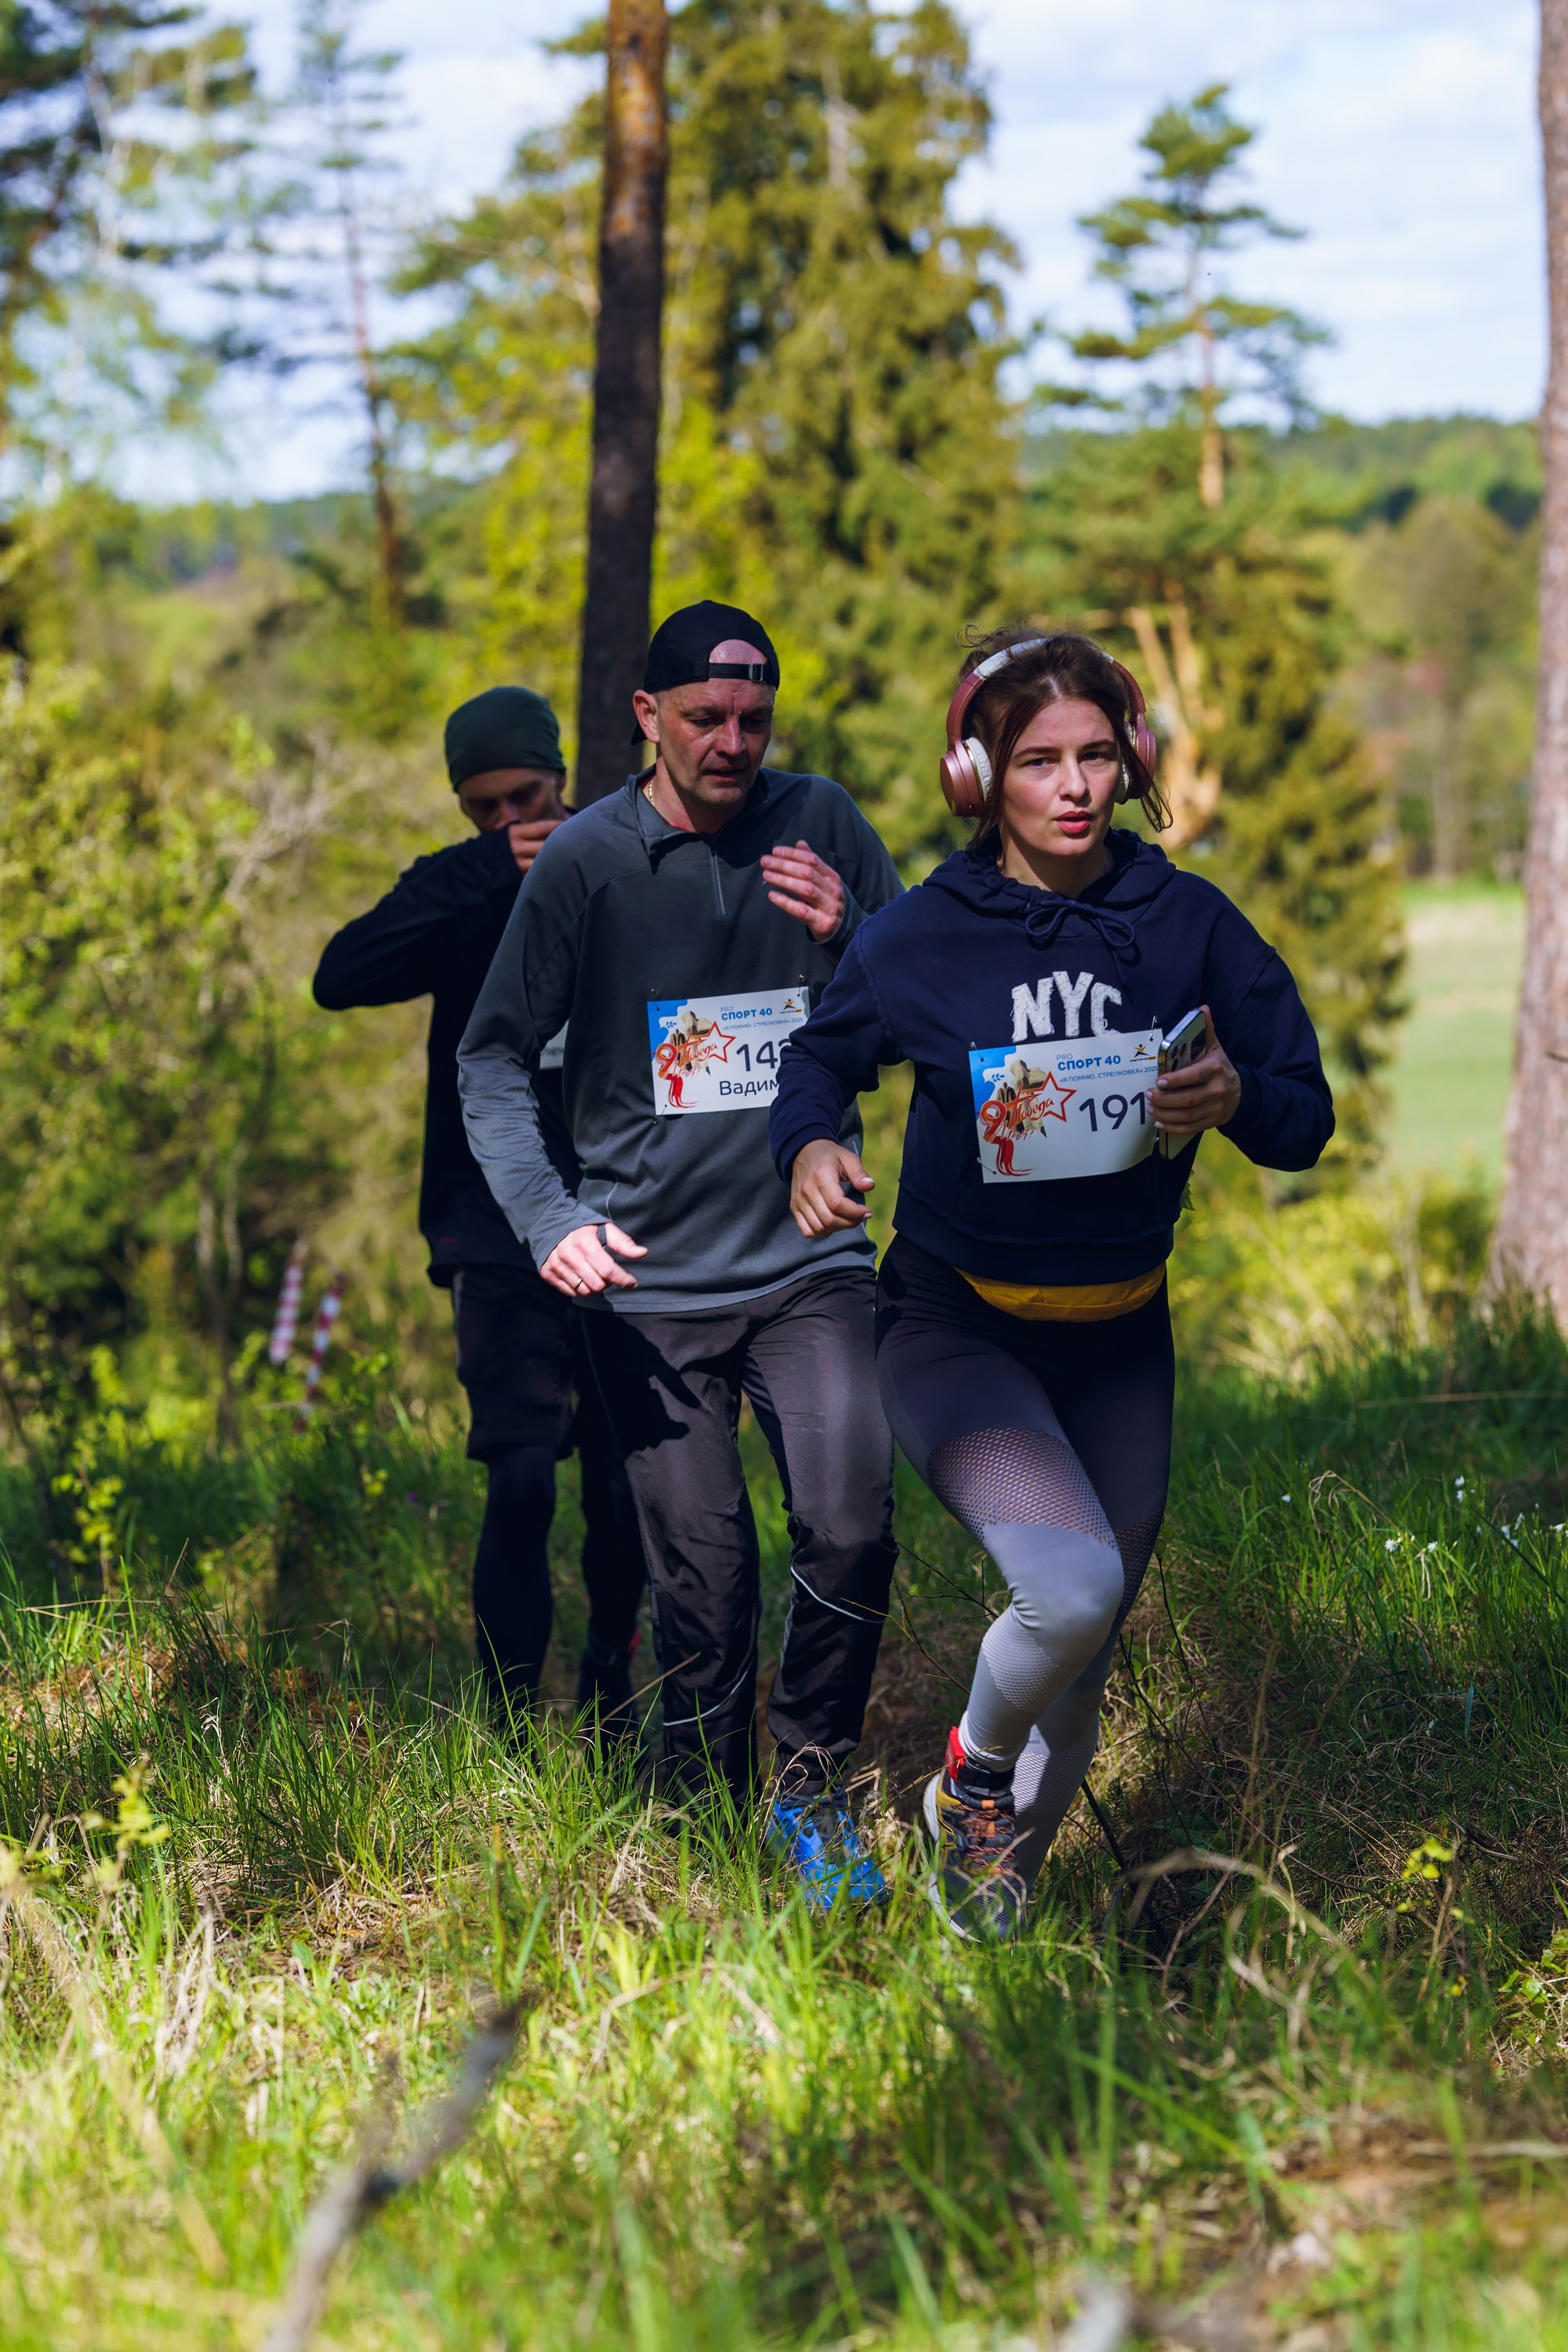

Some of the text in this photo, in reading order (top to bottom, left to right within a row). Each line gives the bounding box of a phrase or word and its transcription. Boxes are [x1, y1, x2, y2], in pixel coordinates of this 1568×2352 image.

[721, 1009, 757, 1021] СПОРТ
[759, 1007, 773, 1016] 40
[1010, 971, 1123, 1044] NYC
[736, 1038, 792, 1073] 14
[1056, 1053, 1073, 1062] PRO
[1058, 1057, 1102, 1071] СПОРТ
[1105, 1054, 1122, 1065] 40
[1079, 1091, 1146, 1132] 191
